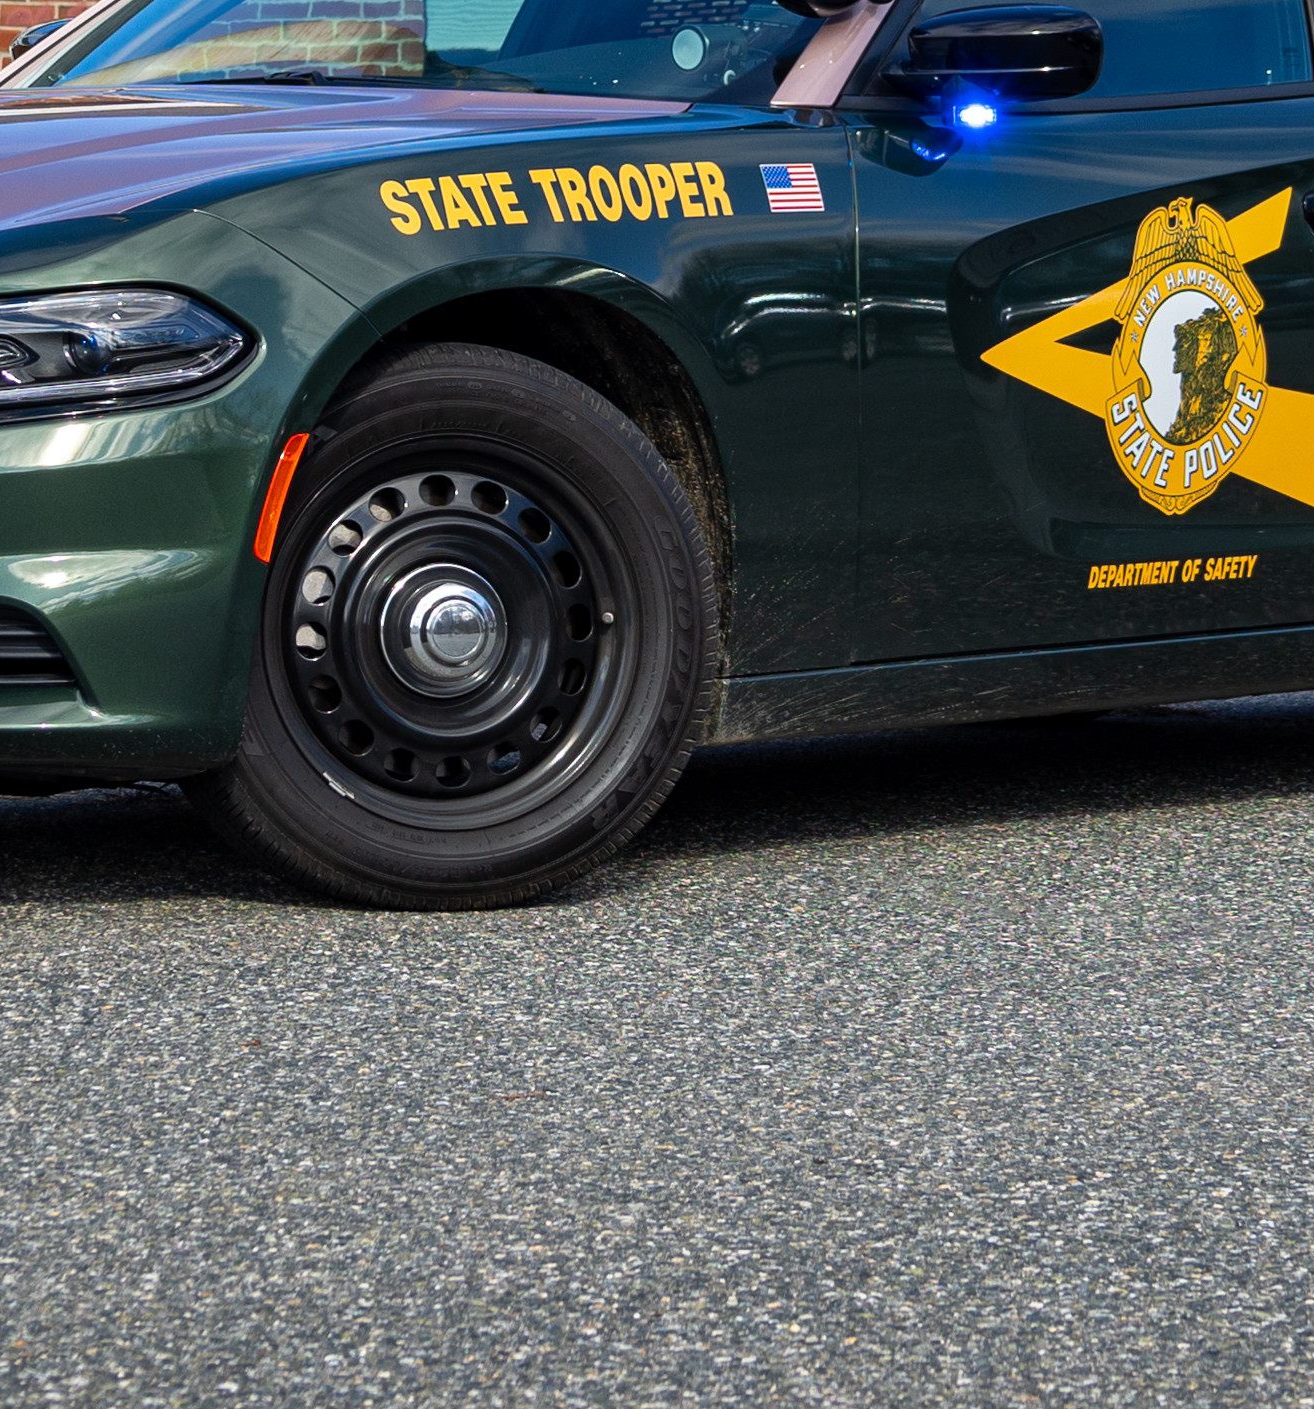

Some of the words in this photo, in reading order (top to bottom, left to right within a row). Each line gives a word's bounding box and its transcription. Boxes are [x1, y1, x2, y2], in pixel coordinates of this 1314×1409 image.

[380, 171, 528, 235] STATE
[529, 161, 734, 223] TROOPER
[1132, 284, 1161, 328] NEW
[1164, 268, 1244, 323] HAMPSHIRE
[1111, 392, 1175, 488] STATE
[1184, 382, 1263, 489] POLICE
[1088, 560, 1179, 589] DEPARTMENT
[1181, 558, 1202, 583] OF
[1204, 555, 1258, 581] SAFETY
[590, 514, 694, 830] GOODYEAR
